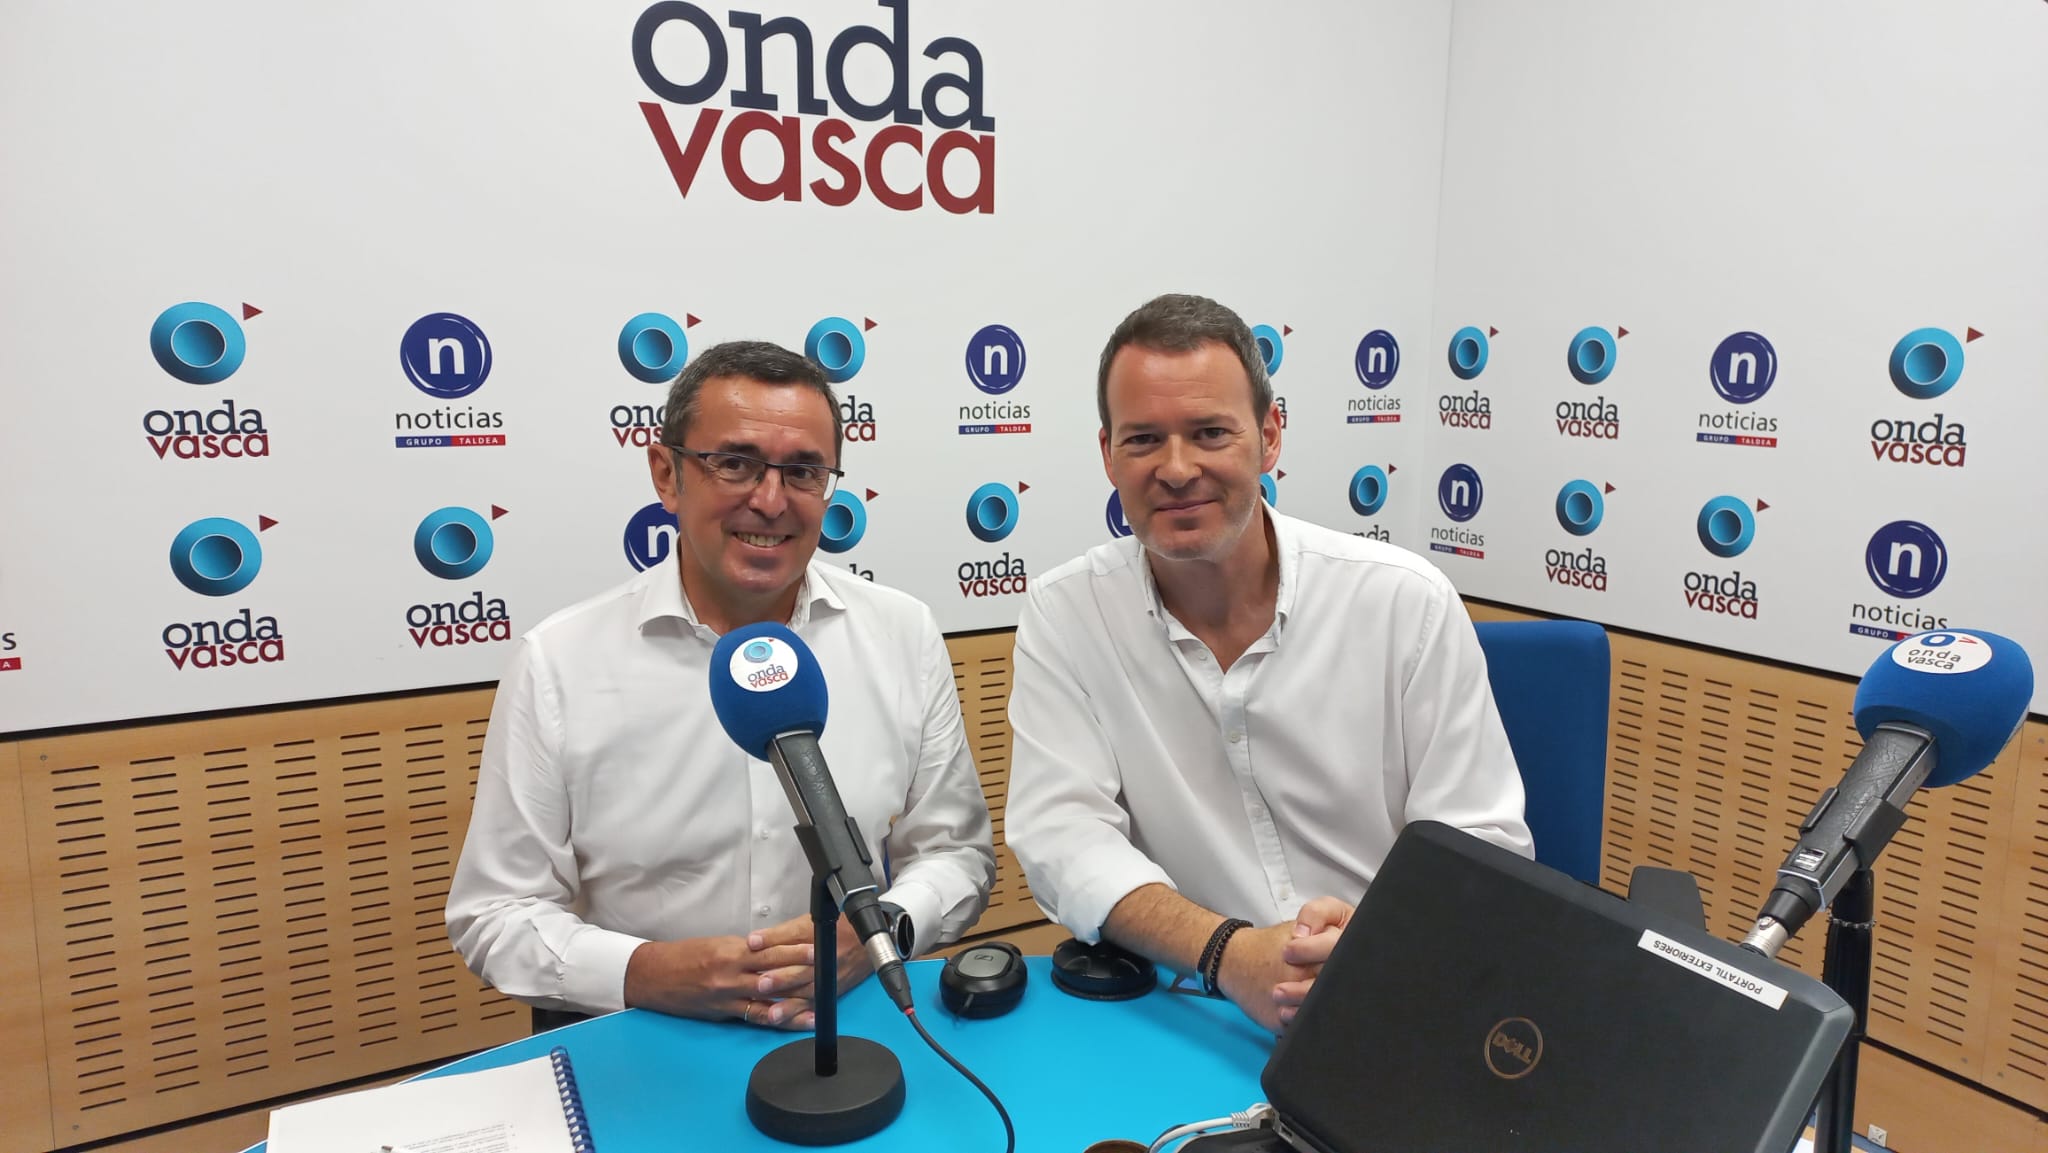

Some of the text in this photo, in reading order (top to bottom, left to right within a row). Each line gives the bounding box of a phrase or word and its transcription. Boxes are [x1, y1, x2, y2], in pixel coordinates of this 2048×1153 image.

[632, 0, 995, 132] onda
[638, 101, 995, 214] vasca
[960, 400, 1031, 421] noticias
[1348, 395, 1400, 412] noticias
[1439, 390, 1491, 414] onda
[1556, 397, 1619, 422] onda
[143, 400, 268, 436] onda
[396, 406, 504, 431] noticias
[964, 426, 991, 434] GRUPO
[1439, 411, 1491, 430] vasca
[1556, 419, 1619, 440] vasca
[1698, 411, 1778, 433] noticias
[1871, 414, 1966, 446] onda
[146, 432, 269, 460] vasca
[406, 436, 498, 447] GRUPO TALDEA
[1703, 434, 1772, 447] GRUPO TALDEA
[1871, 440, 1966, 468] vasca
[1431, 527, 1484, 546] noticias
[958, 552, 1027, 581] onda
[1545, 549, 1607, 575] onda
[959, 576, 1027, 598] vasca
[1545, 567, 1608, 592] vasca
[1684, 572, 1759, 602] onda
[406, 591, 510, 628] onda
[1684, 589, 1759, 620] vasca
[1852, 603, 1949, 630] noticias
[162, 608, 282, 648] onda
[408, 618, 511, 649] vasca
[1857, 627, 1889, 639] GRUPO
[165, 639, 285, 671] vasca
[1907, 656, 1955, 670] vasca
[1908, 649, 1962, 663] onda
[748, 664, 785, 682] onda
[750, 671, 789, 688] vasca
[1653, 939, 1763, 995] PORTATIL EXTERIORES
